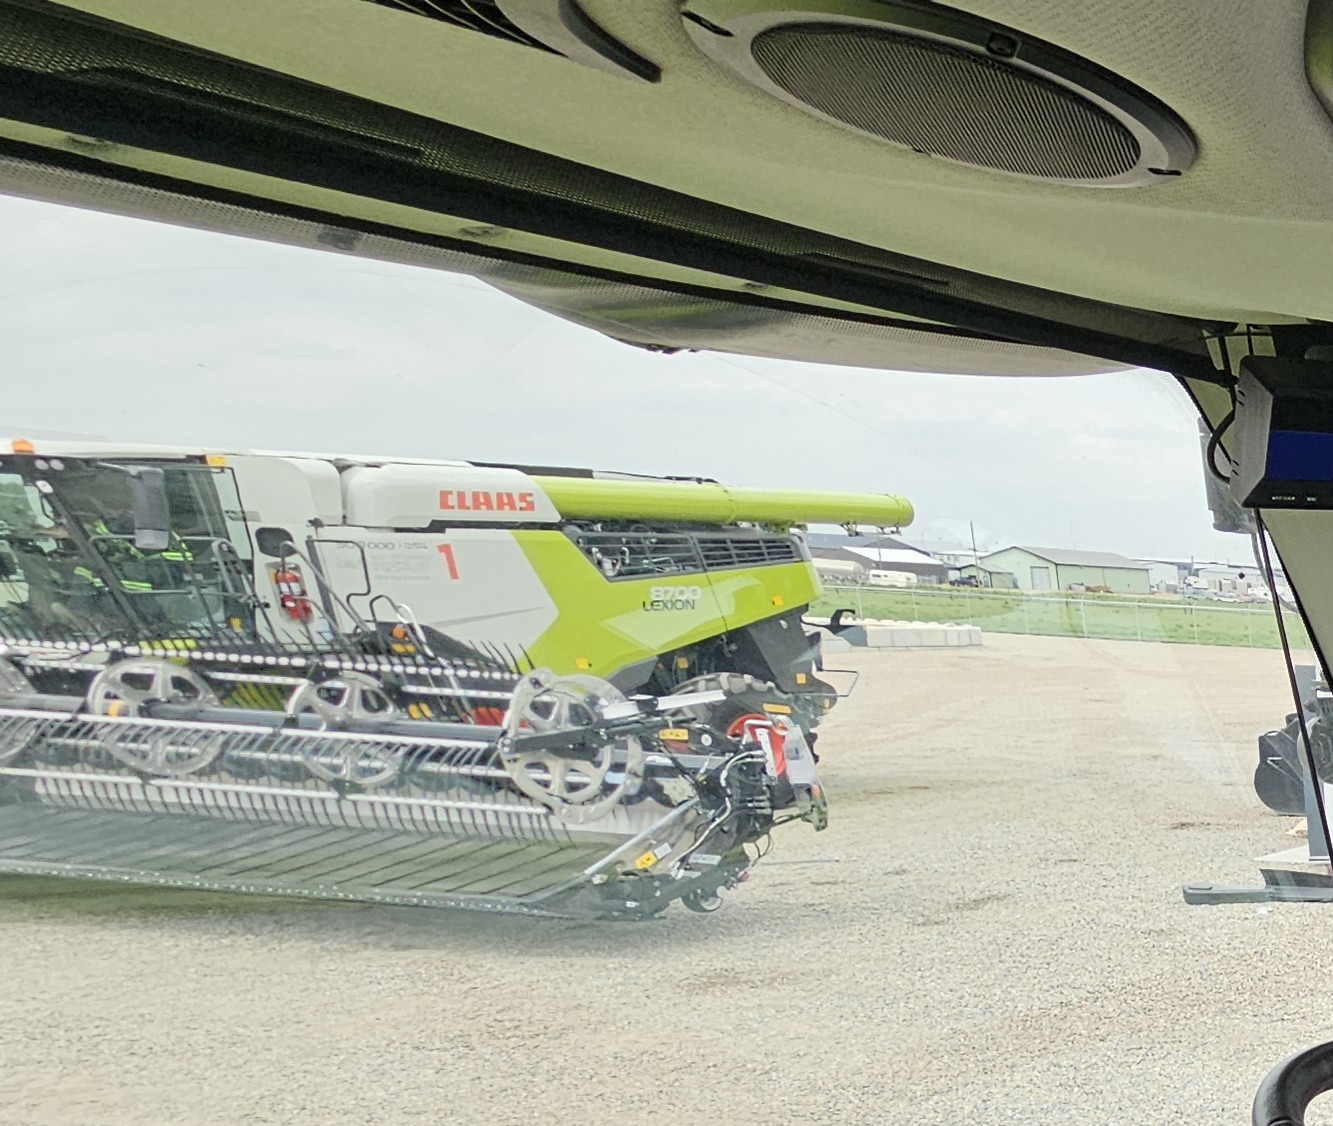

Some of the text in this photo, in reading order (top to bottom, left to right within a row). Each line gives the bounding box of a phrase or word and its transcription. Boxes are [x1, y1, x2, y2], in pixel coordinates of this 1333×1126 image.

[439, 490, 535, 512] CLAAS
[437, 543, 459, 580] 1
[649, 585, 703, 601] 8700
[642, 599, 696, 612] LEXION
